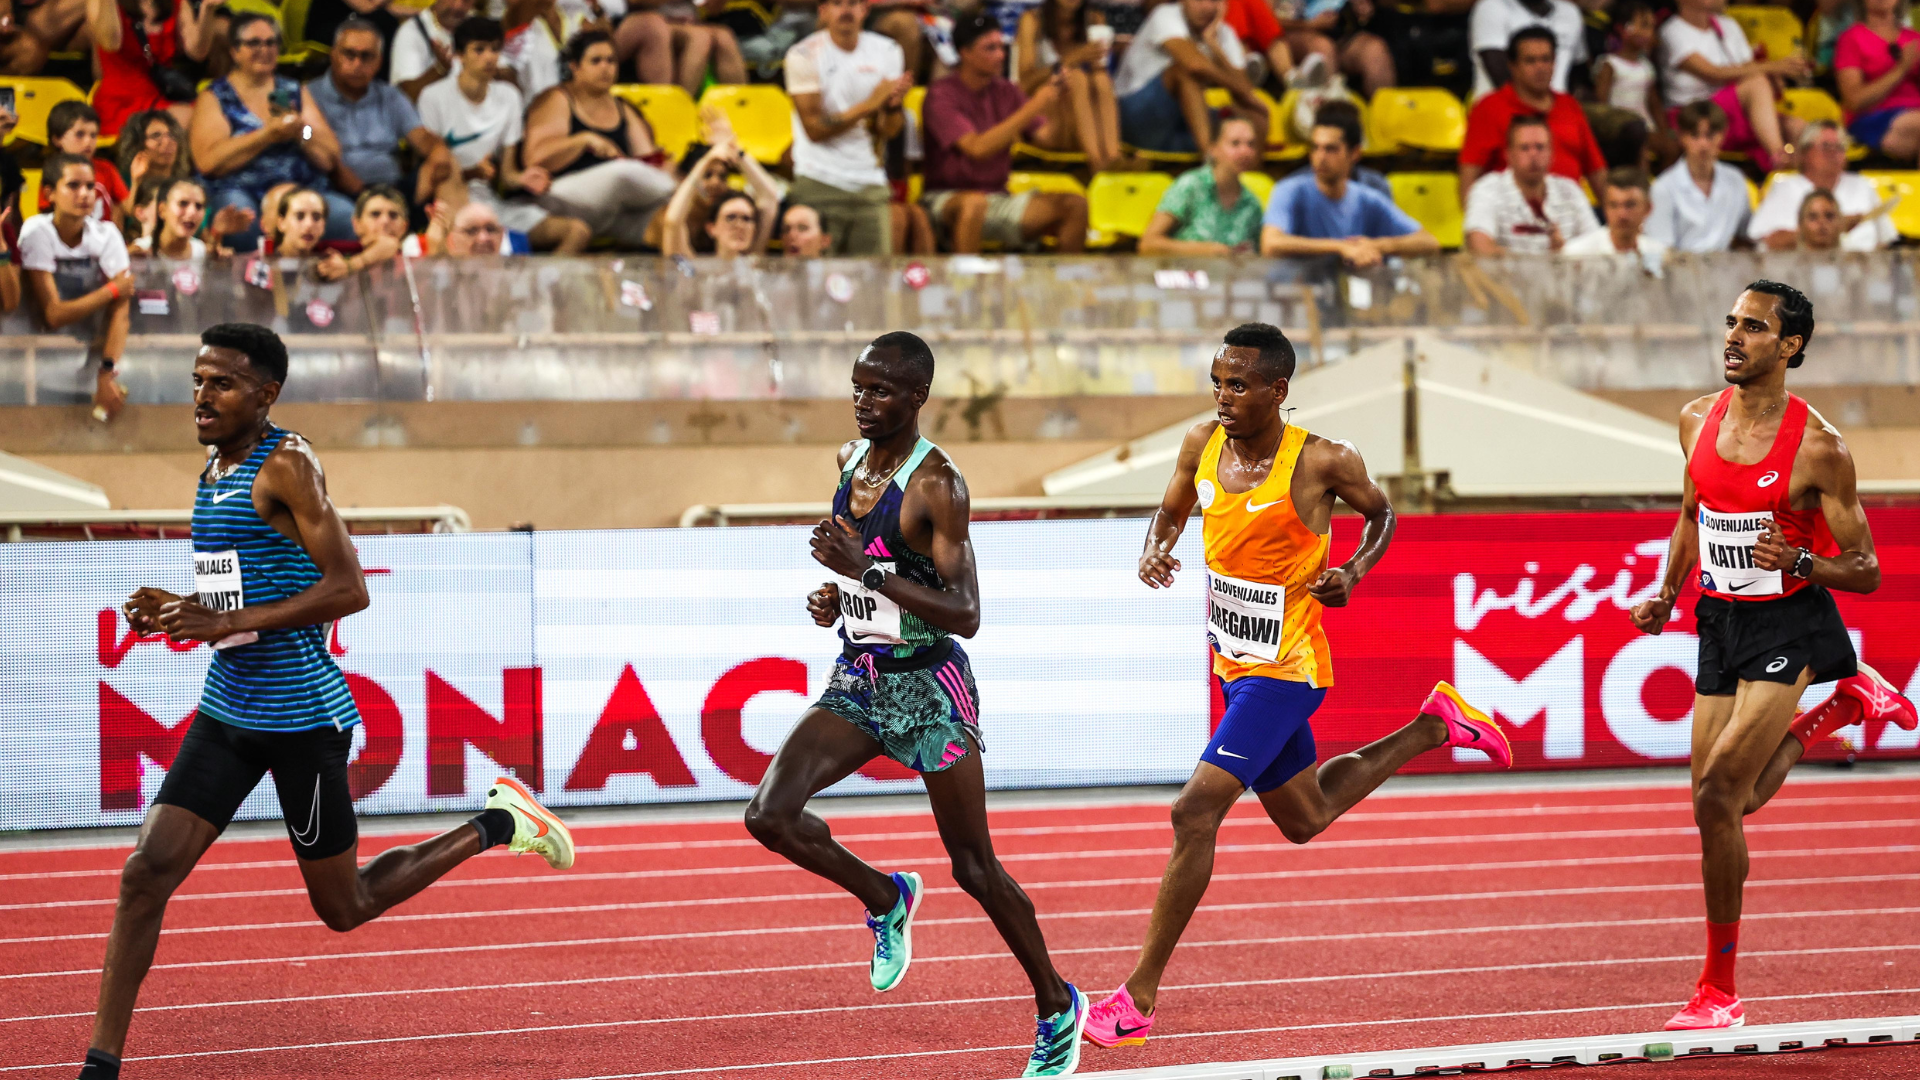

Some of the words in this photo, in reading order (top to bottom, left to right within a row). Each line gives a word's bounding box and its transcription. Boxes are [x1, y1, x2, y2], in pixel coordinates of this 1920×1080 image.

[1213, 578, 1278, 605] SLOVENIJALES
[1210, 598, 1281, 646] AREGAWI
[1805, 699, 1838, 737] PARIS
